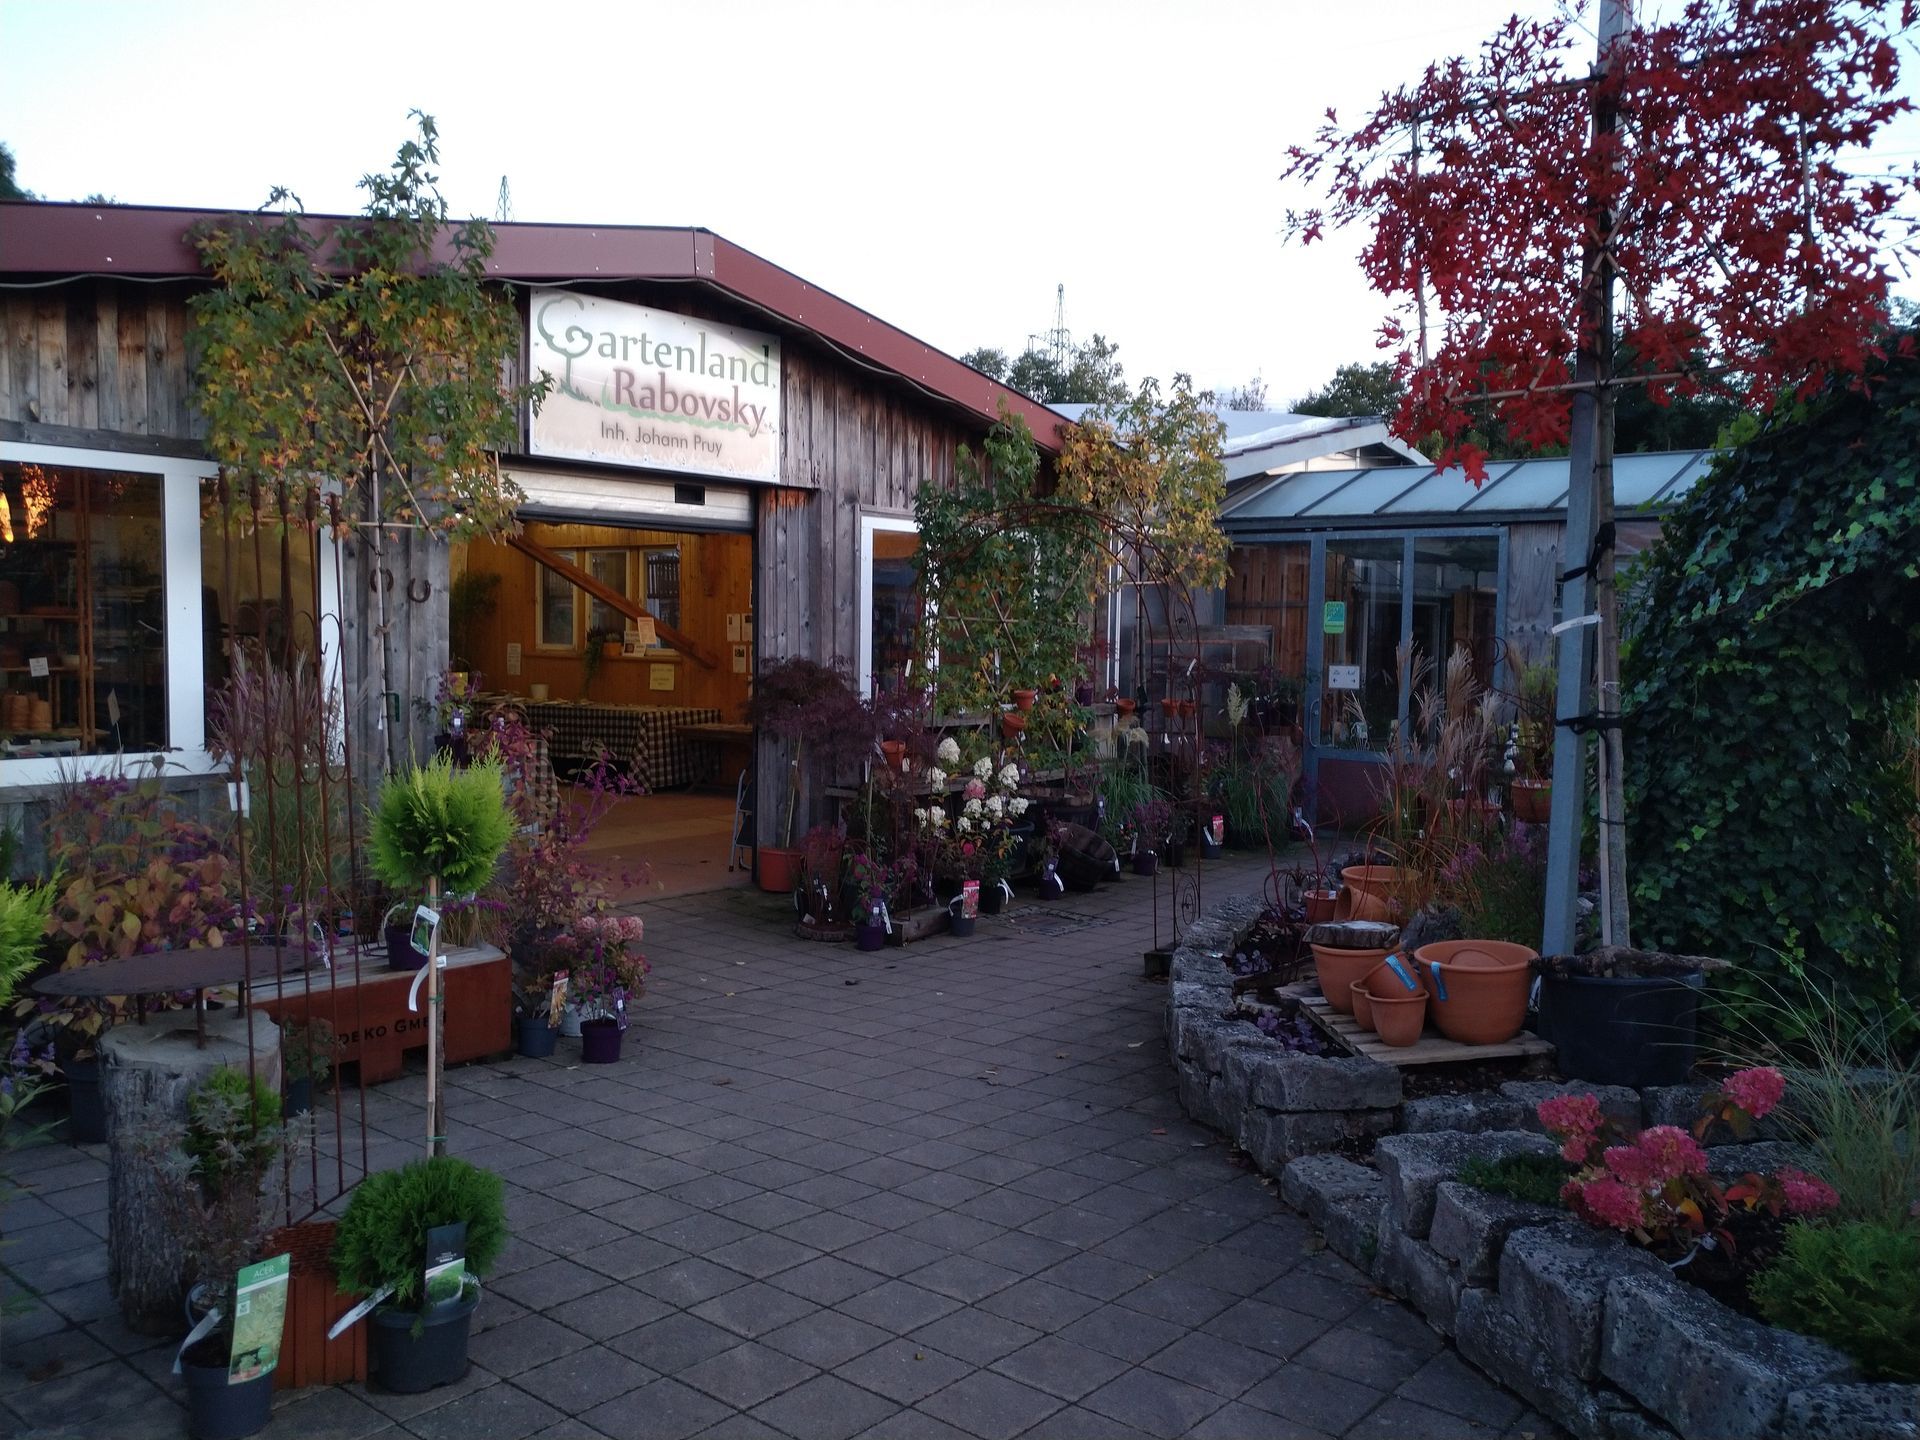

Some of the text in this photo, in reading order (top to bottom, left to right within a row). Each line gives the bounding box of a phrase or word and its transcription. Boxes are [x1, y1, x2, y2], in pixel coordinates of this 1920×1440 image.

[537, 295, 769, 391] Gartenland
[613, 367, 767, 438] Rabovsky
[601, 422, 723, 457] Inh. Johann Pruy
